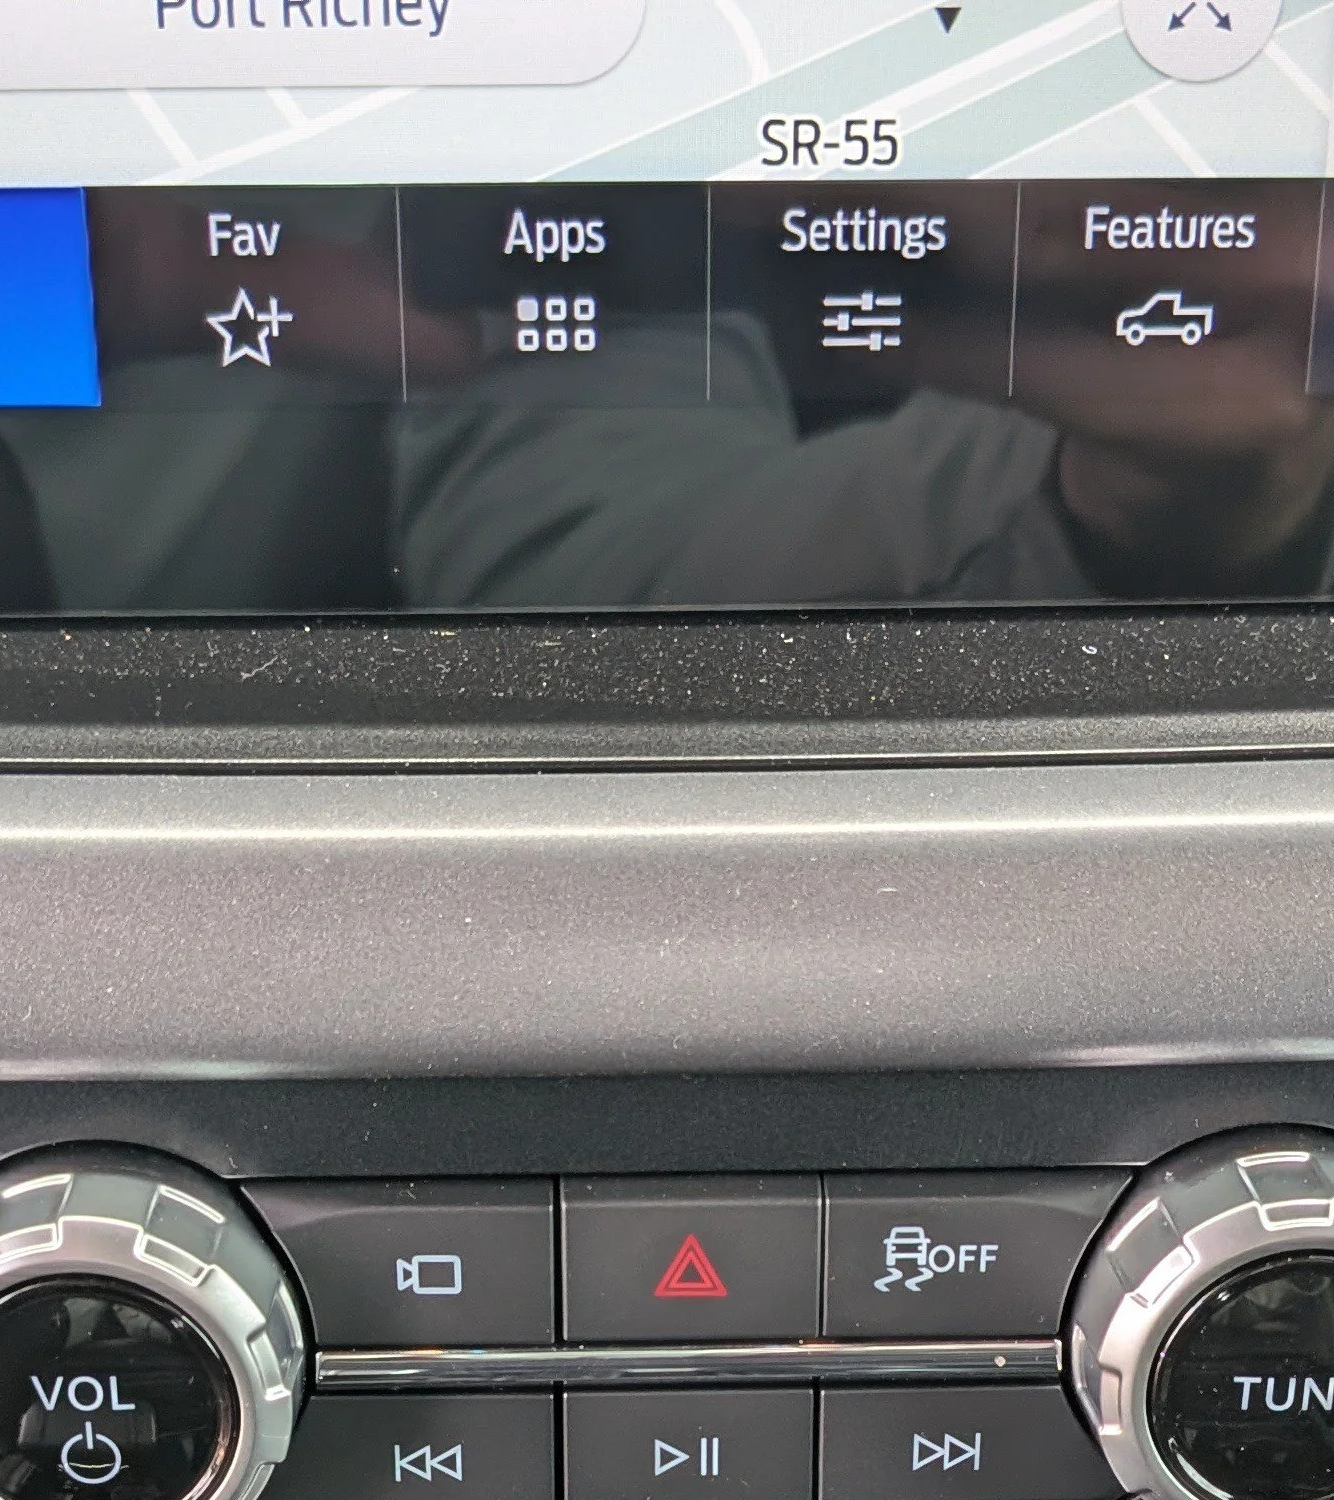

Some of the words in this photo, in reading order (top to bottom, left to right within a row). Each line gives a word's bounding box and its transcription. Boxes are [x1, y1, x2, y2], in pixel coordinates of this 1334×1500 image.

[761, 118, 899, 166] SR-55
[208, 212, 280, 258] Fav
[504, 209, 606, 263] Apps
[781, 208, 947, 260] Settings
[1083, 206, 1256, 251] Features
[929, 1244, 999, 1274] OFF
[31, 1374, 136, 1413] VOL
